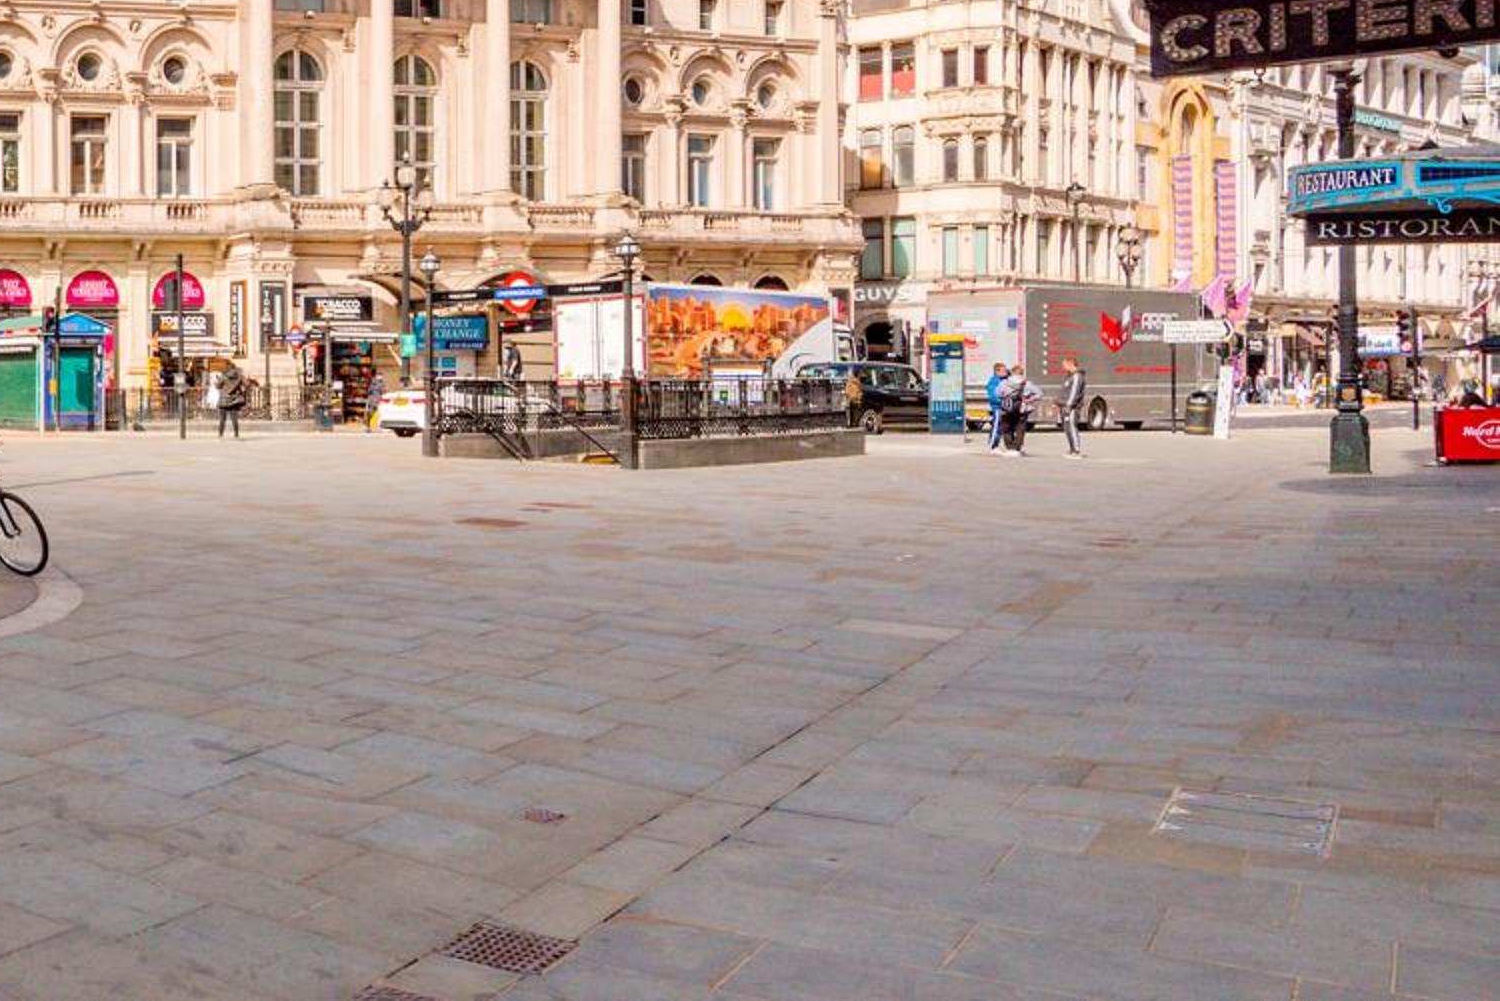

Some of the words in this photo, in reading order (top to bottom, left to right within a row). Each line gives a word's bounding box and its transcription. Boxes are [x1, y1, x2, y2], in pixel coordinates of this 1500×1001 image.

[1299, 167, 1395, 195] RESTAURANT
[855, 287, 910, 302] GUYS
[419, 327, 480, 339] ECHANGE
